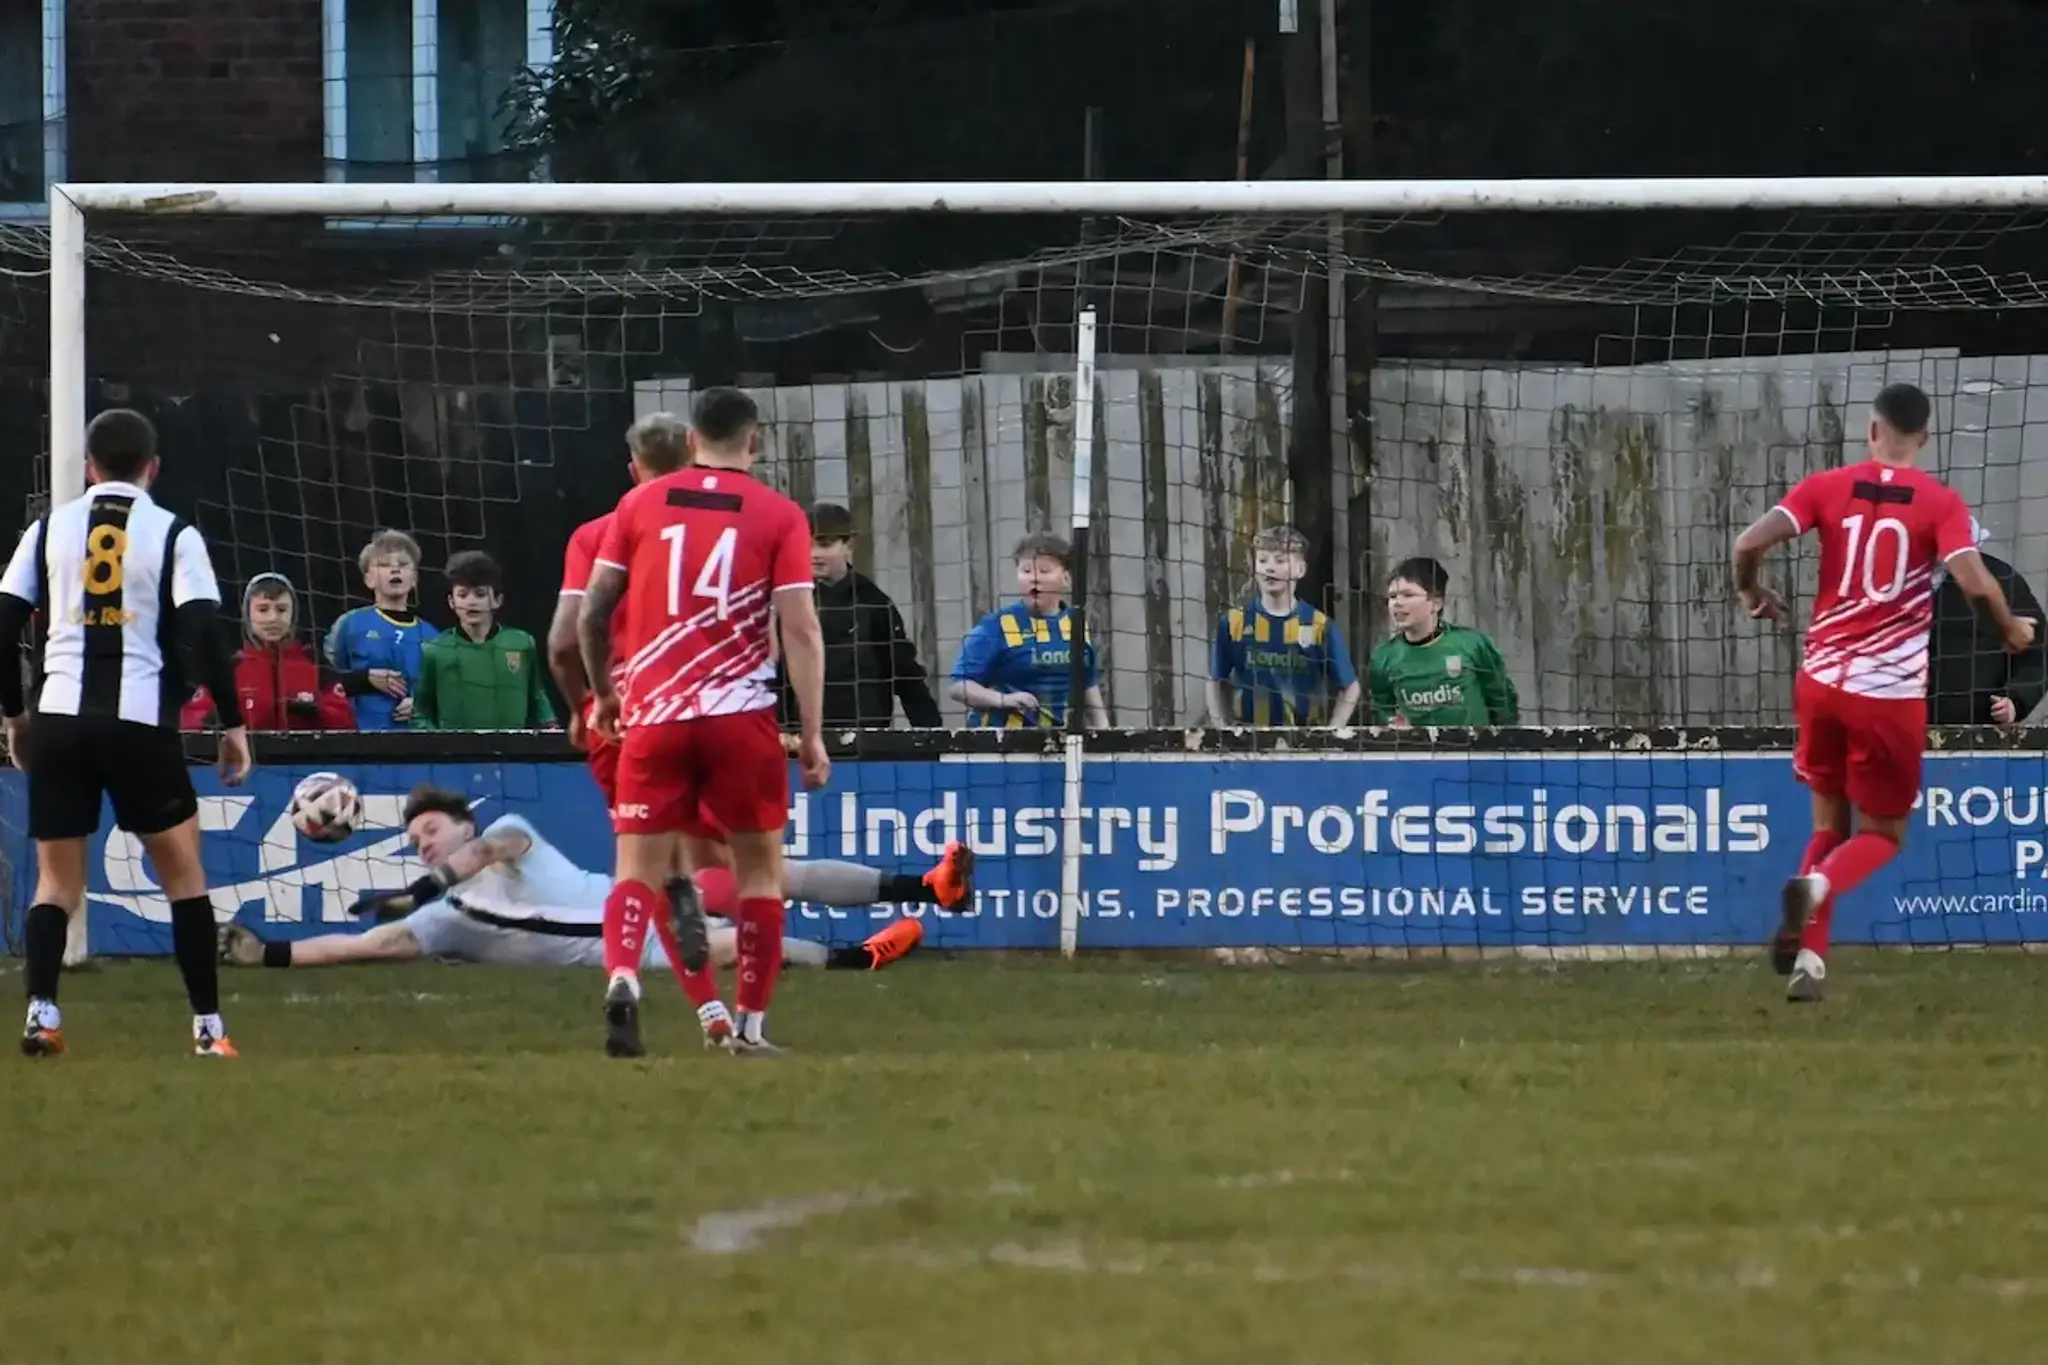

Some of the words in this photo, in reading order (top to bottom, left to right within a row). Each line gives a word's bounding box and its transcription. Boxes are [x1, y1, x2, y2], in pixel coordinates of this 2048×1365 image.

[82, 523, 128, 595] 8
[660, 523, 738, 620] 14
[1838, 514, 1909, 602] 10
[1401, 684, 1463, 706] Londis
[841, 791, 1178, 871] Industry
[1211, 787, 1770, 855] Professionals
[1157, 886, 1502, 919] PROFESSIONAL
[1522, 885, 1708, 917] SERVICE
